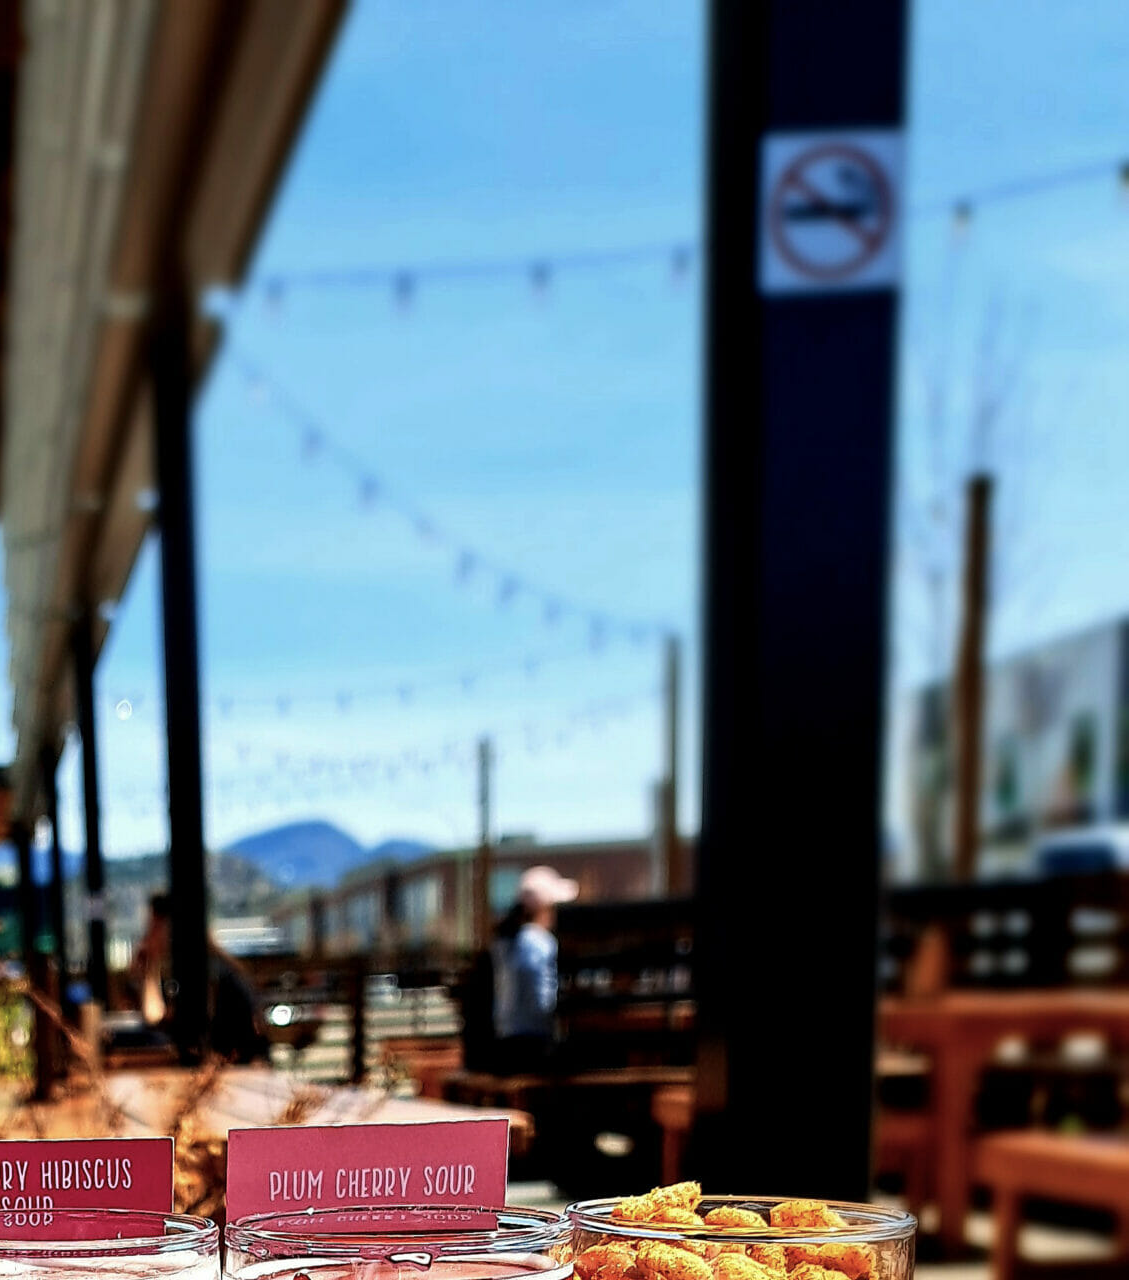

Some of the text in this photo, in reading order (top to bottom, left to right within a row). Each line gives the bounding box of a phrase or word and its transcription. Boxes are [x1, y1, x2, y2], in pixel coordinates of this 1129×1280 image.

[41, 1158, 132, 1190] HIBISCUS
[270, 1164, 476, 1202] PLUM CHERRY SOUR
